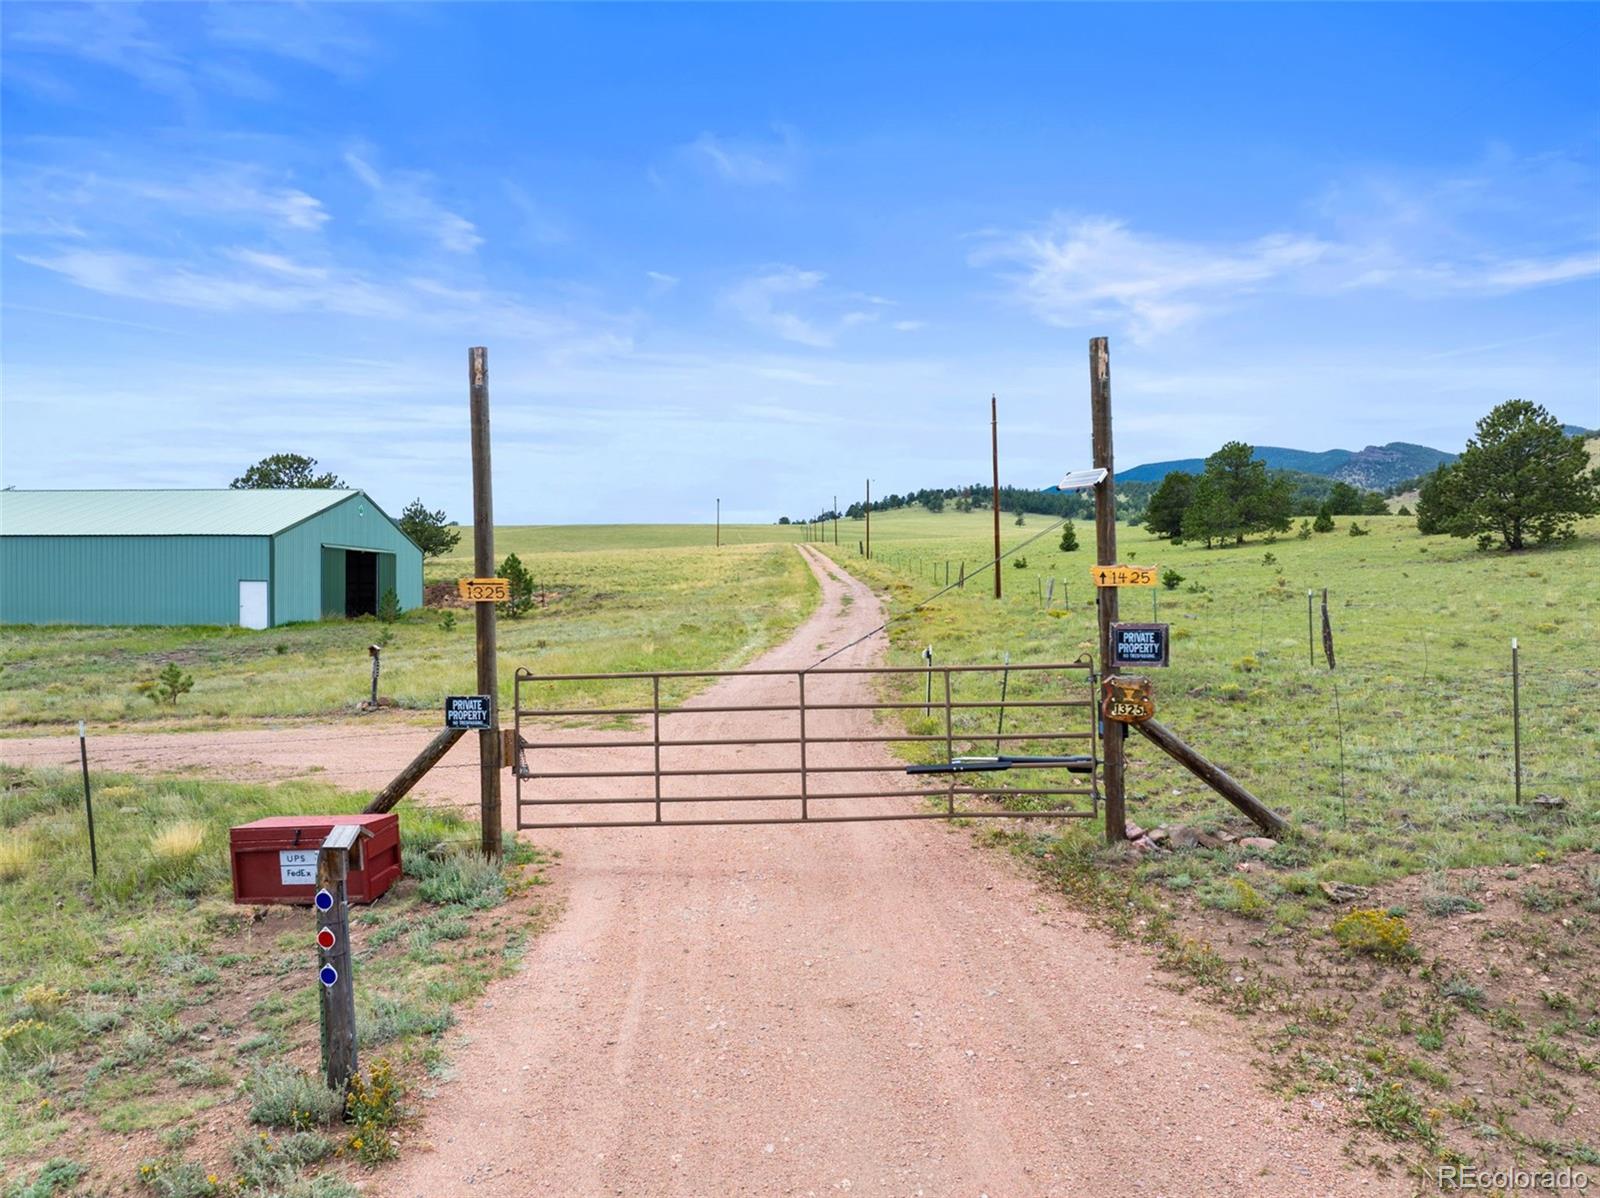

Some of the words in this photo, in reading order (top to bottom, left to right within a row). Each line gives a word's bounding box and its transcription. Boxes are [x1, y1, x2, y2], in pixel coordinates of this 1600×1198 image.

[1112, 572, 1150, 584] 1425
[468, 586, 505, 599] 1325
[1123, 632, 1155, 643] PRIVATE
[1118, 643, 1159, 653] PROPERTY
[452, 700, 482, 710] PRIVATE
[1114, 704, 1143, 715] 1325
[448, 710, 487, 720] PROPERTY
[287, 869, 311, 877] FedEx
